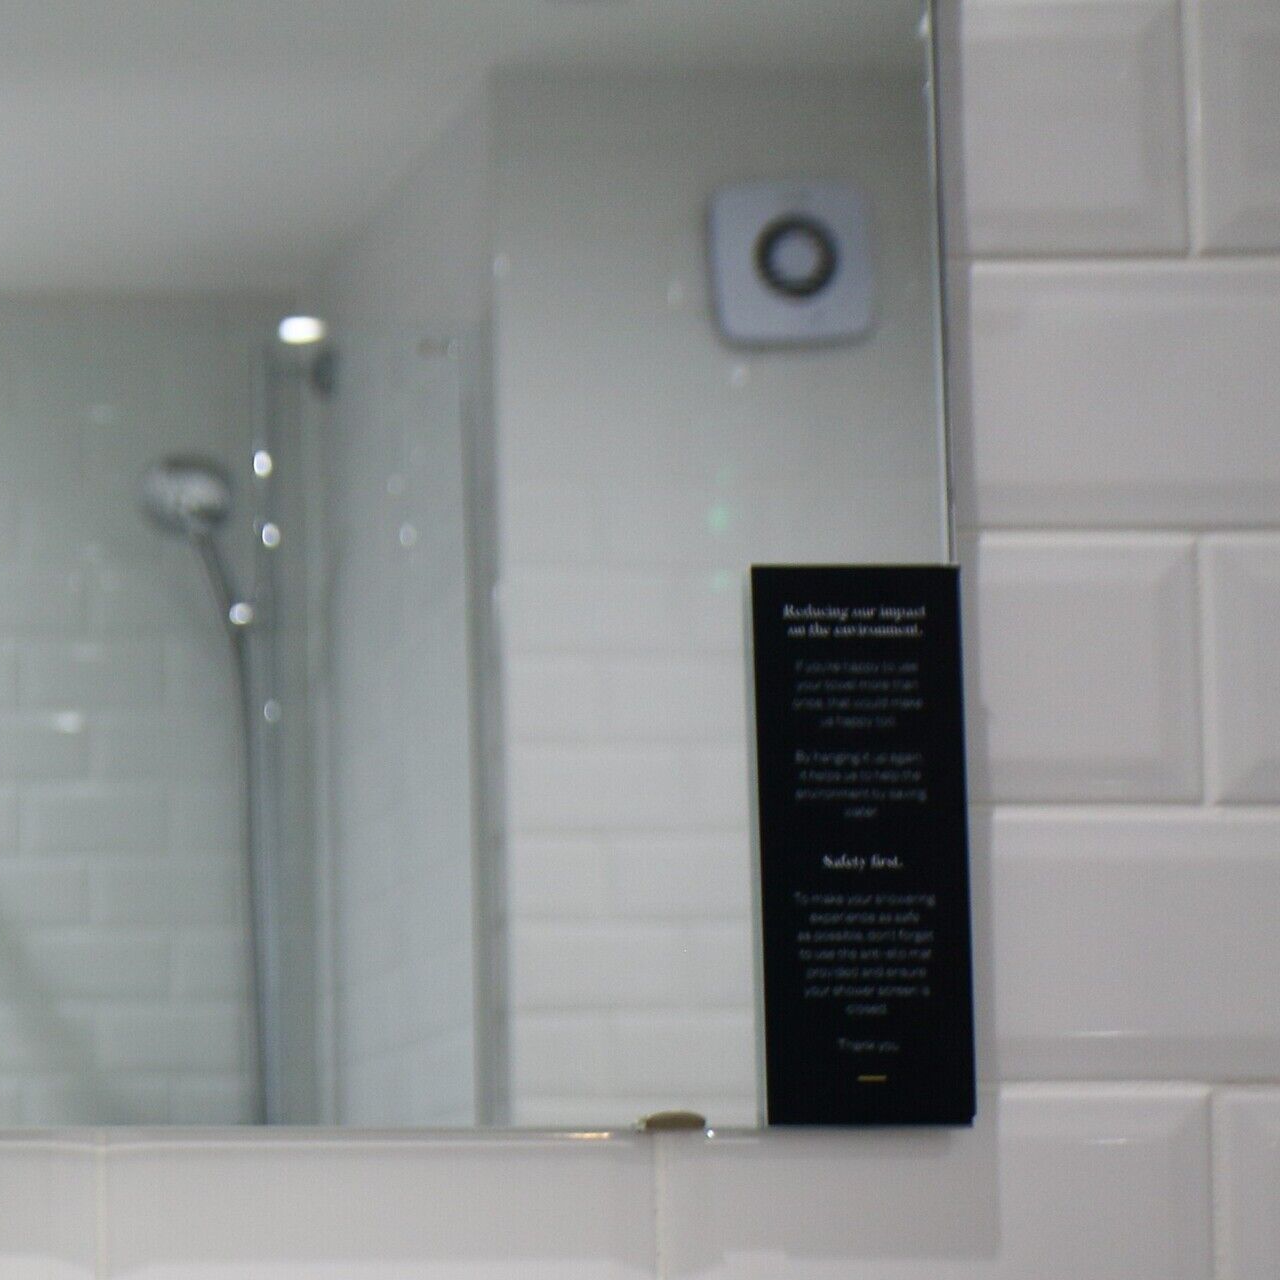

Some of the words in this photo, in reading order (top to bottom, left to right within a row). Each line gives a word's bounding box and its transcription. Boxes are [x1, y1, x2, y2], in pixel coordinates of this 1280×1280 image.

[782, 603, 849, 622] Reducing
[851, 606, 877, 619] our
[878, 605, 926, 622] impact
[787, 624, 806, 638] on
[808, 622, 830, 638] the
[822, 854, 866, 872] Safety
